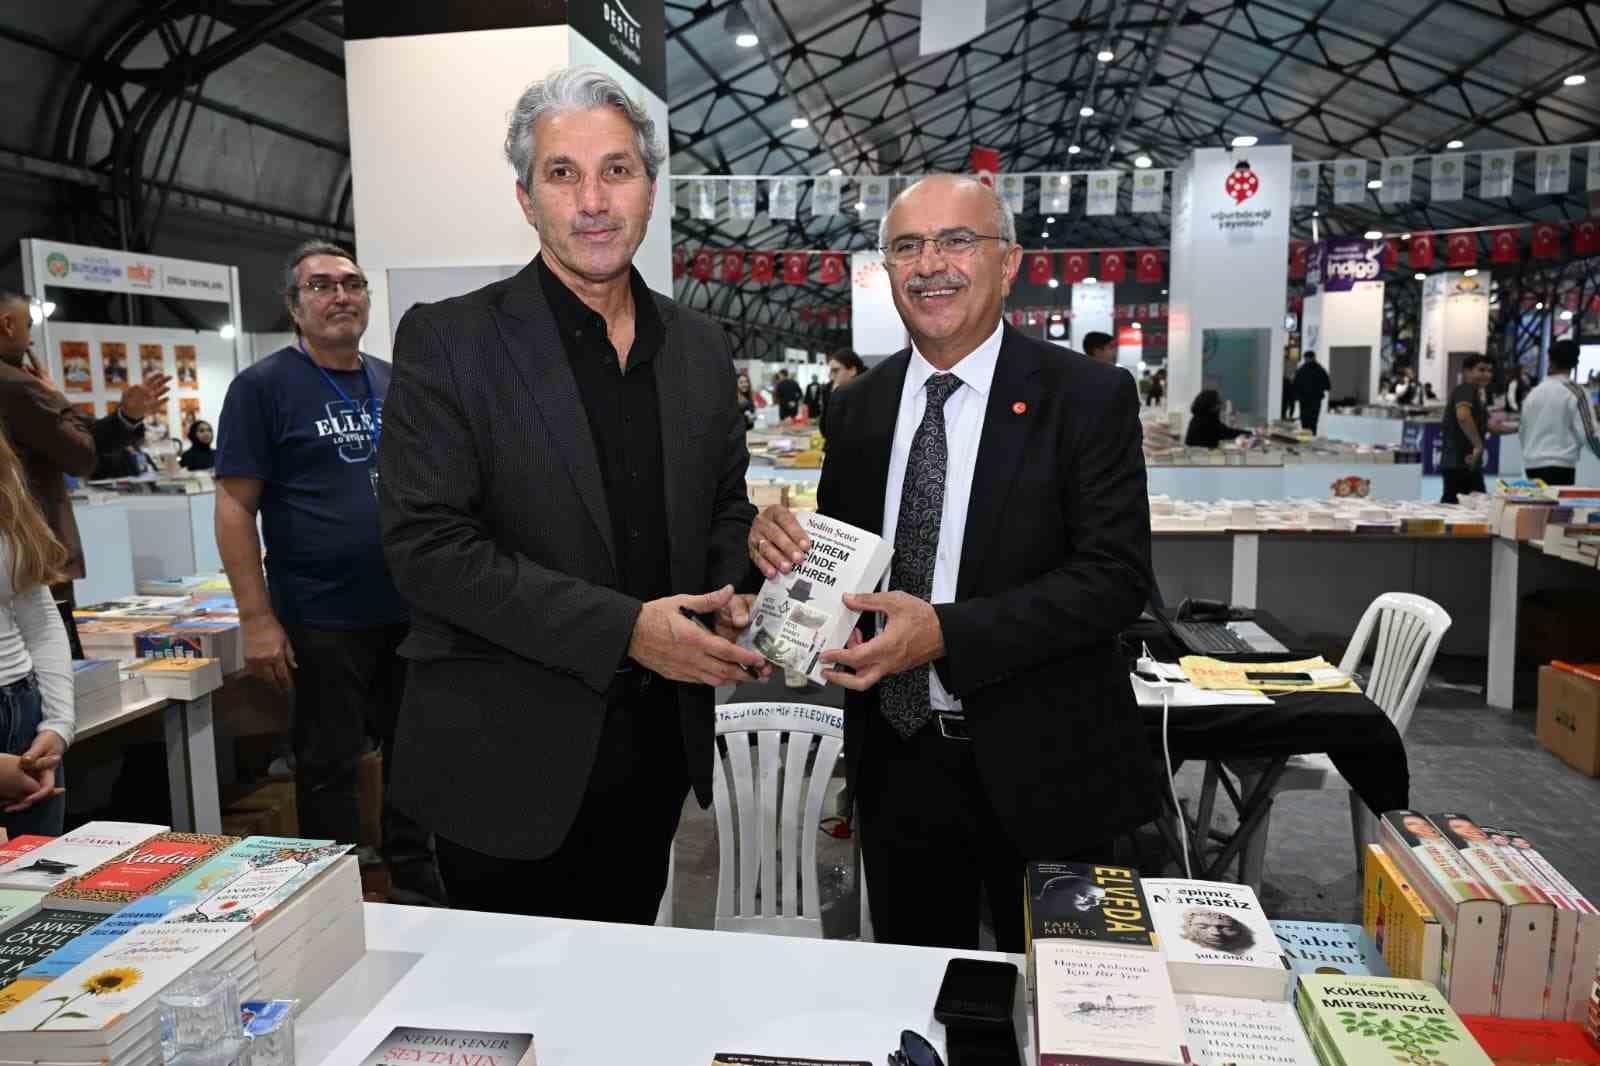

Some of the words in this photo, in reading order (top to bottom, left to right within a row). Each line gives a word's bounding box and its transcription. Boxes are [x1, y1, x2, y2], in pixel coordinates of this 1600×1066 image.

[603, 3, 640, 50] DESTEK
[807, 518, 834, 535] Nedim
[809, 539, 850, 562] AHREM
[1094, 865, 1146, 932] ELVEDA
[1323, 986, 1431, 1002] Köklerimiz
[1321, 999, 1447, 1016] Mirasımızdır
